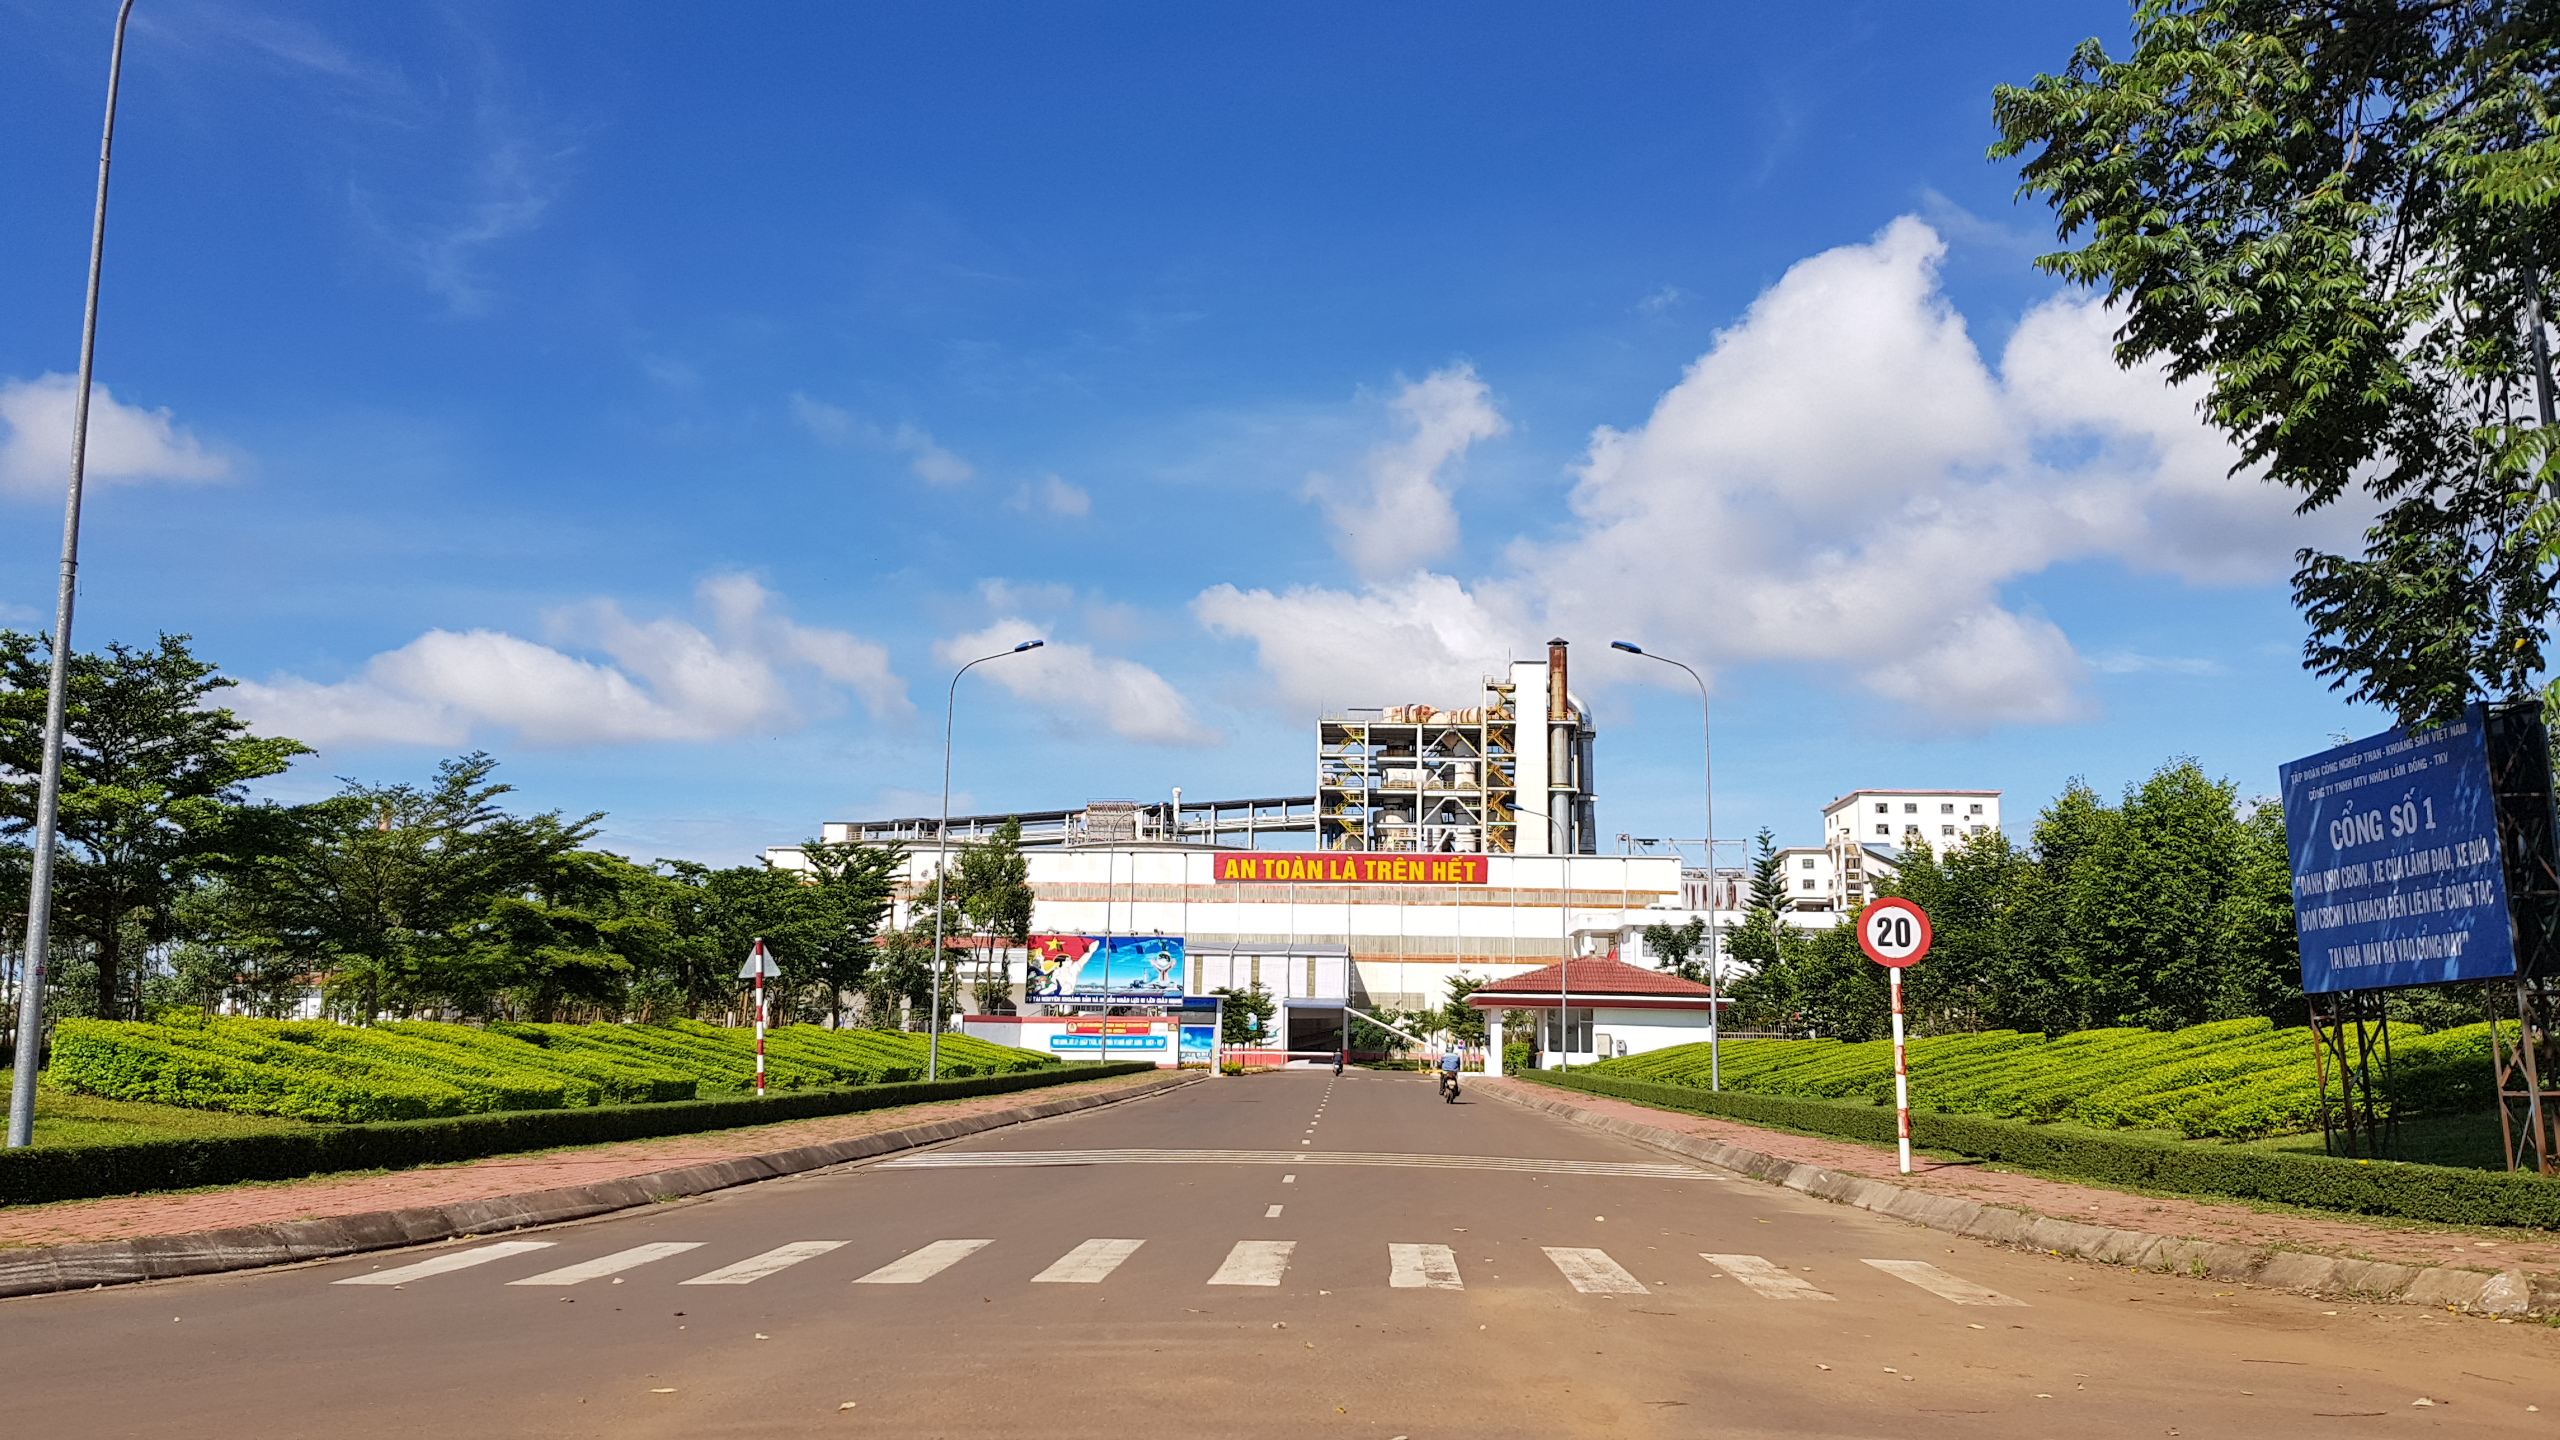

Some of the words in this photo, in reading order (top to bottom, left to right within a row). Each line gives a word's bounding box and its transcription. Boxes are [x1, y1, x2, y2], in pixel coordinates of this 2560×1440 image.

[2291, 770, 2303, 786] TẬP
[2304, 765, 2320, 781] ĐOÀN
[2320, 760, 2338, 776] CÔNG
[2338, 753, 2363, 770] NGHIỆP
[2364, 749, 2382, 763] THAN
[2386, 738, 2414, 756] KHOÁNG
[2414, 731, 2430, 748] SẢN
[2432, 728, 2448, 745] VIỆT
[2450, 722, 2468, 738] NAM
[2308, 786, 2325, 801] CÔNG
[2325, 783, 2334, 796] TY
[2335, 778, 2352, 794] TNHH
[2353, 774, 2368, 788] MTV
[2368, 768, 2390, 785] NHÔM
[2390, 763, 2406, 778] LÂM
[2433, 752, 2449, 766] TKV
[2330, 800, 2384, 850] CỔNG
[2390, 787, 2418, 837] SỐ
[2423, 796, 2436, 830] 1
[1224, 858, 1256, 879] AN
[1262, 856, 1323, 880] TOÀN
[1330, 856, 1358, 880] LÀ
[1364, 857, 1427, 882] TRÊN
[1432, 855, 1477, 882] HẾT
[2323, 868, 2340, 892] CHO
[2341, 862, 2372, 888] CBCNV,
[2372, 859, 2385, 883] XE
[2386, 849, 2405, 880] CỦA
[2404, 847, 2430, 873] LÃNH
[2430, 846, 2454, 878] ĐẠO,
[2454, 842, 2468, 868] XE
[2300, 904, 2319, 932] ĐÓN
[2318, 904, 2344, 929] CBCNV
[2344, 898, 2358, 925] VÀ
[2358, 893, 2386, 924] KHÁCH
[2387, 884, 2407, 918] ĐẾN
[2408, 886, 2432, 916] LIÊN
[2432, 882, 2444, 918] HỆ
[2446, 878, 2473, 908] CÔNG
[2473, 874, 2494, 905] TÁC
[1877, 917, 1911, 948] 20
[2328, 948, 2344, 974] TẠI
[2344, 940, 2362, 968] NHÀ
[2362, 937, 2382, 966] MÁY
[2382, 940, 2396, 963] RA
[2396, 933, 2416, 962] VÀO
[2416, 924, 2442, 960] CỔNG
